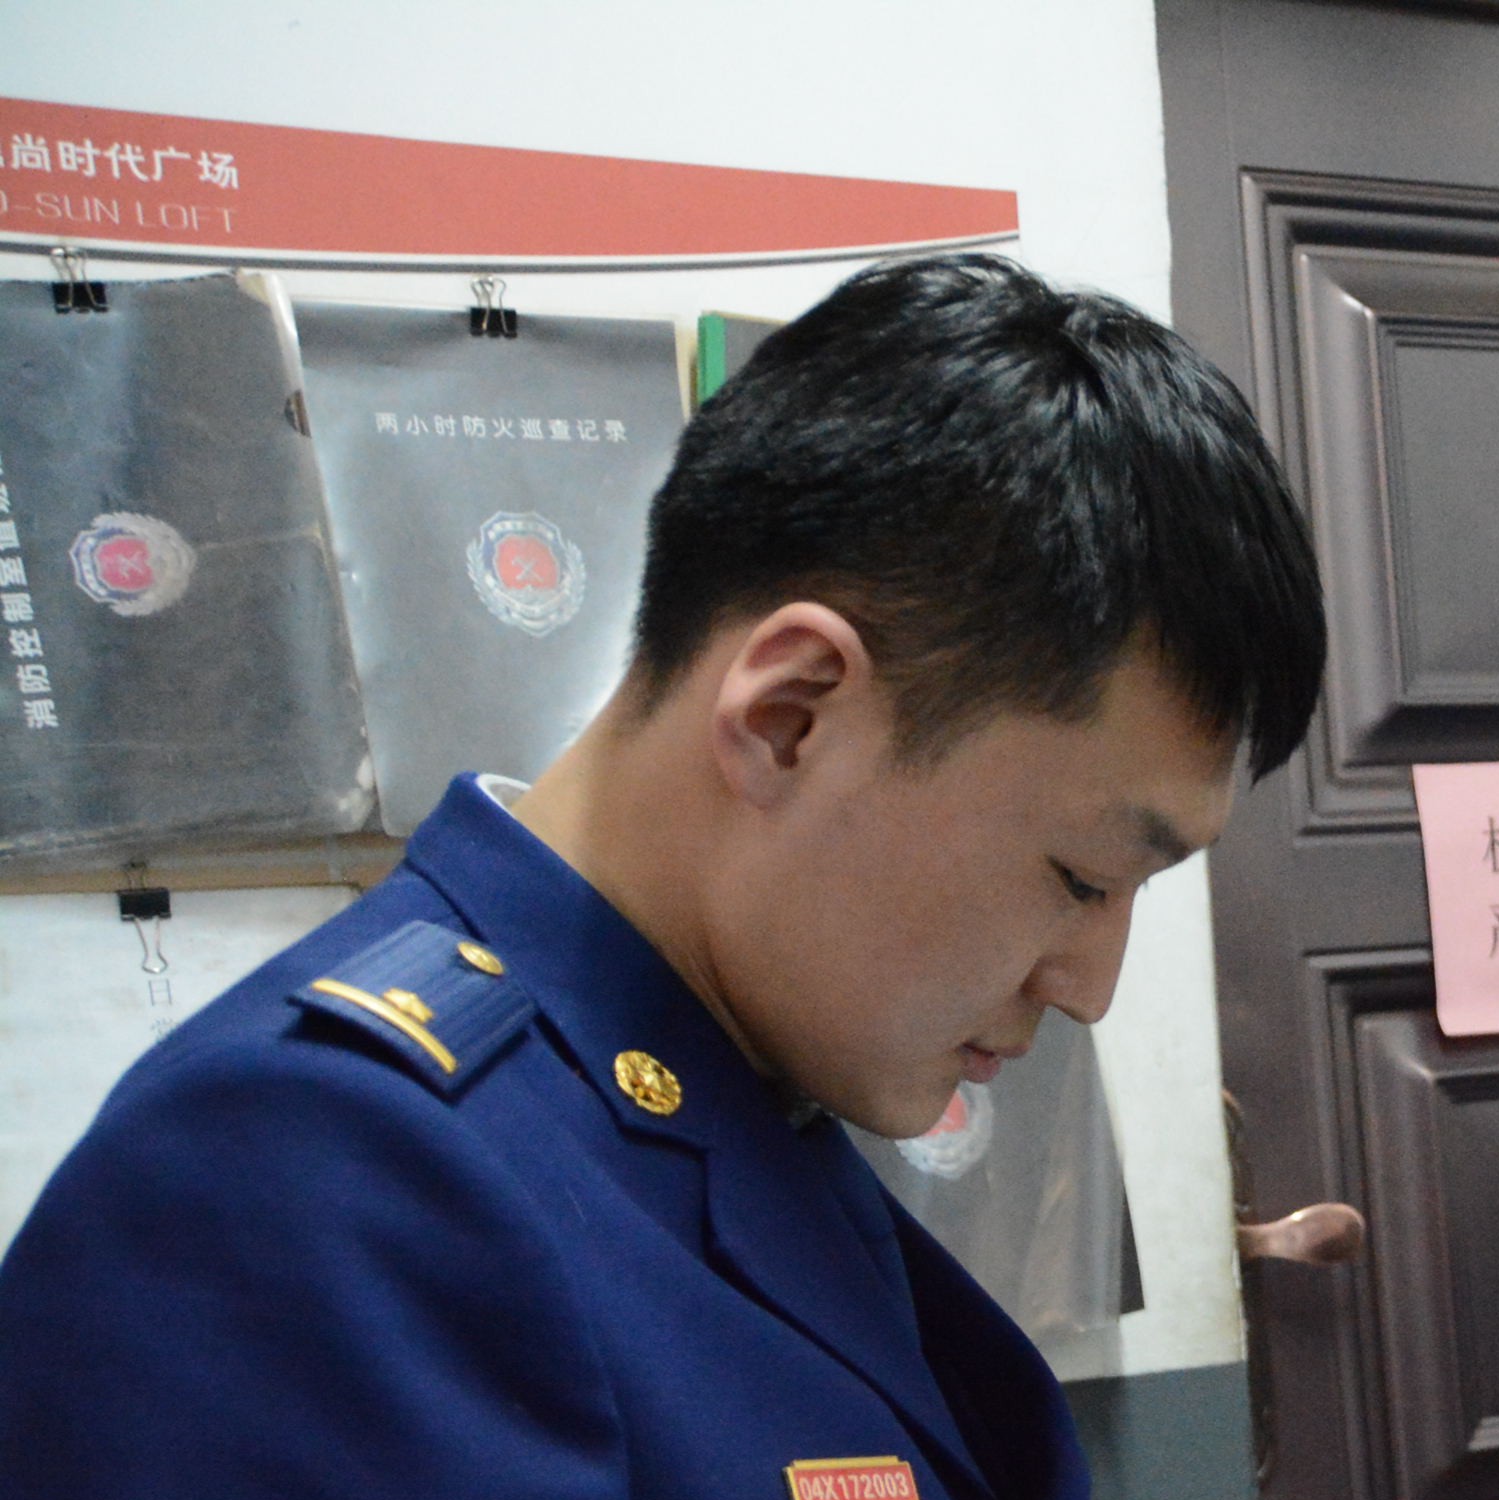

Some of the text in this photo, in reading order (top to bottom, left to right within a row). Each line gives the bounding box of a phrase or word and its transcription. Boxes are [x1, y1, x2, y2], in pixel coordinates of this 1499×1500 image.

[0, 132, 240, 189] 尚时代广场
[135, 198, 237, 234] LOFT
[375, 411, 629, 443] 两小时防火巡查记录
